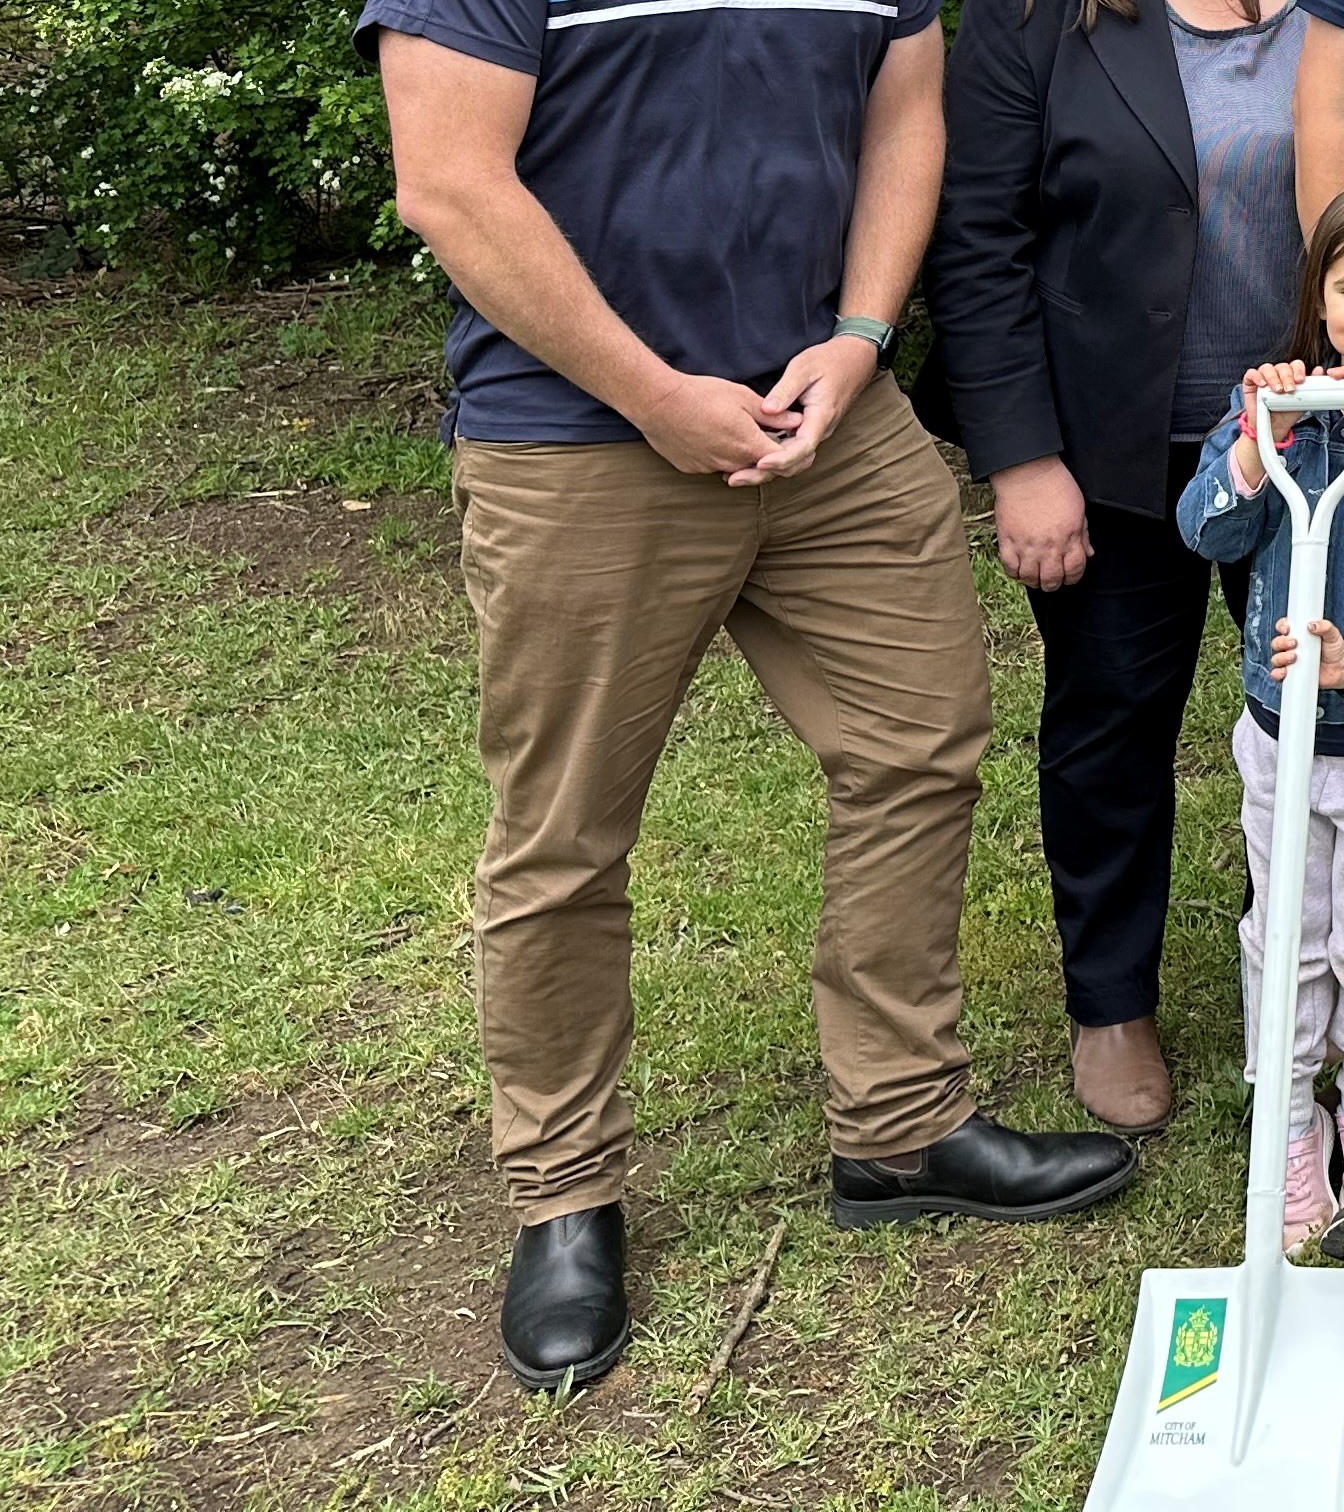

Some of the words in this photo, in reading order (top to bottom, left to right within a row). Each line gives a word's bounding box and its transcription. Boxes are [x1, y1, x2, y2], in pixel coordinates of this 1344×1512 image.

[1164, 1421, 1184, 1431] CITY
[1184, 1421, 1196, 1431] OF
[1149, 1432, 1206, 1445] MITCHAM
